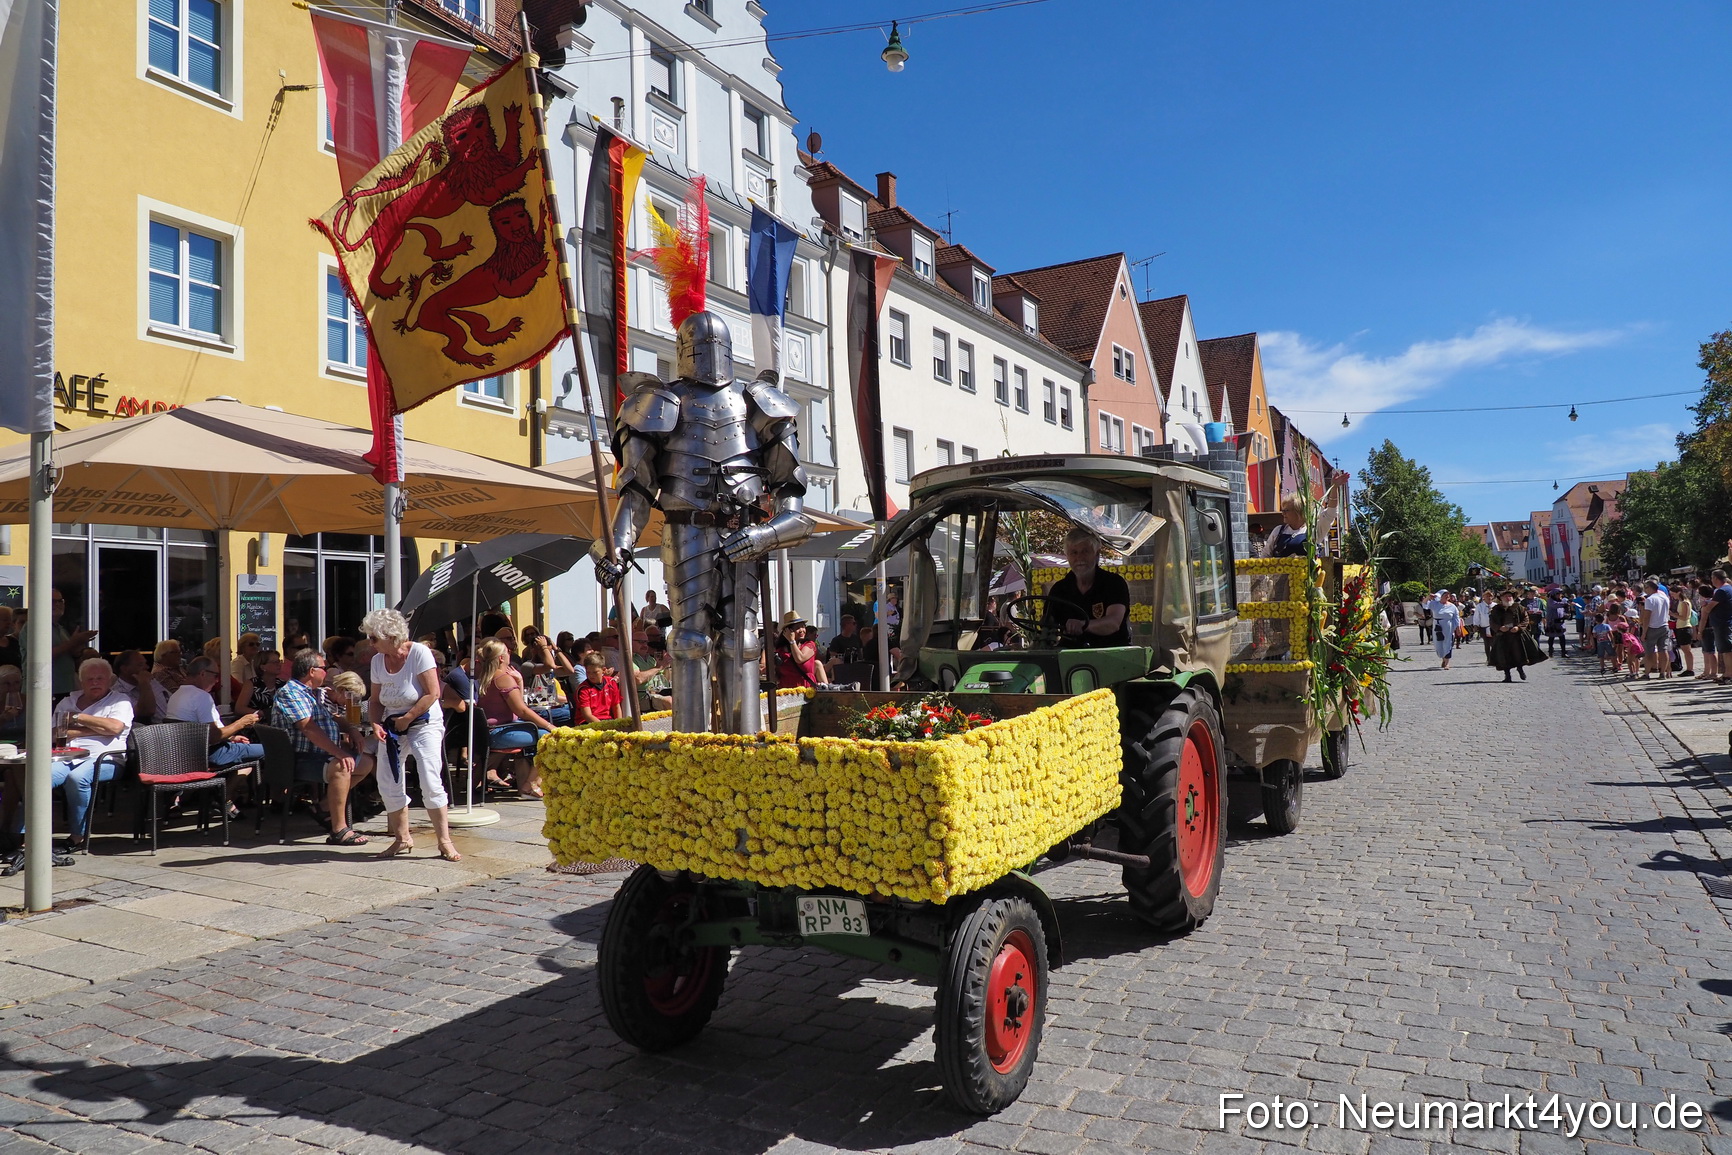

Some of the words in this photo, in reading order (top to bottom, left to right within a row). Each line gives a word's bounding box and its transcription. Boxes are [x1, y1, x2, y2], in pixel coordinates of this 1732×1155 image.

[53, 371, 109, 413] AFÉ
[116, 395, 149, 417] AM
[817, 899, 848, 915] NM
[805, 916, 831, 933] RP
[842, 917, 863, 933] 83
